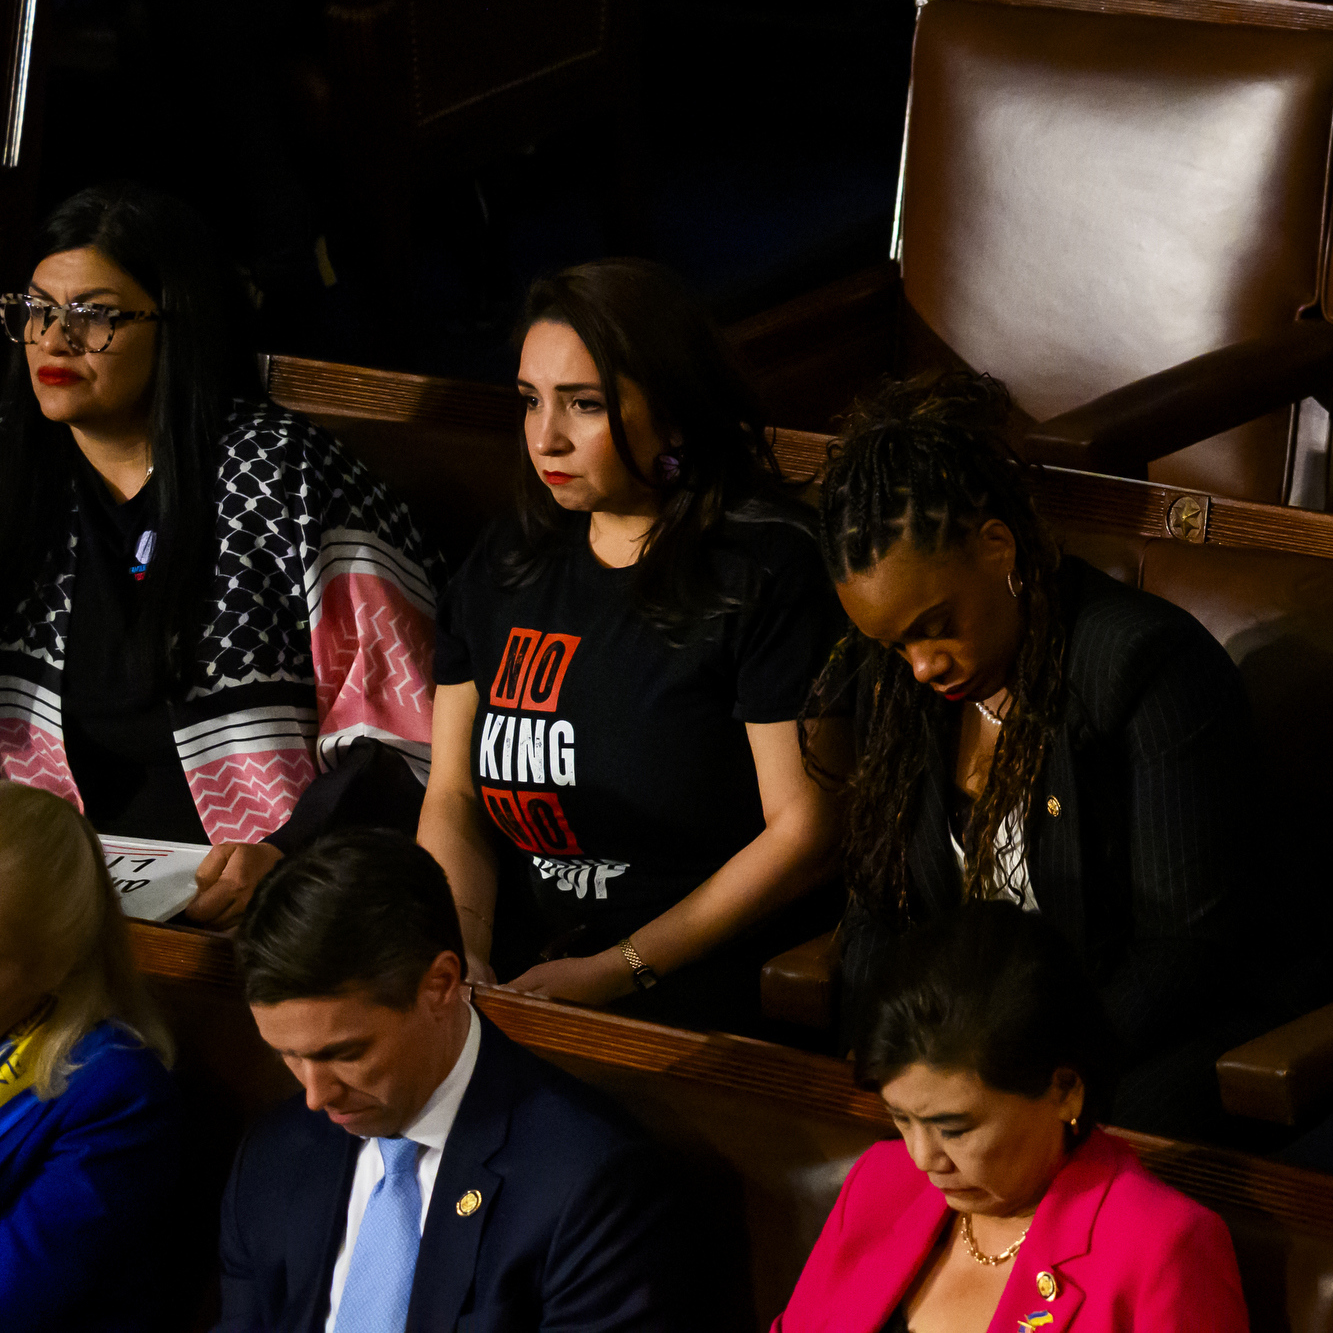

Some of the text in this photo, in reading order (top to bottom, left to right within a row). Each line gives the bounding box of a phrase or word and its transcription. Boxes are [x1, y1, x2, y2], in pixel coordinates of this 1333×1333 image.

[493, 632, 571, 706] NO
[479, 712, 577, 787] KING
[484, 791, 573, 852] NO
